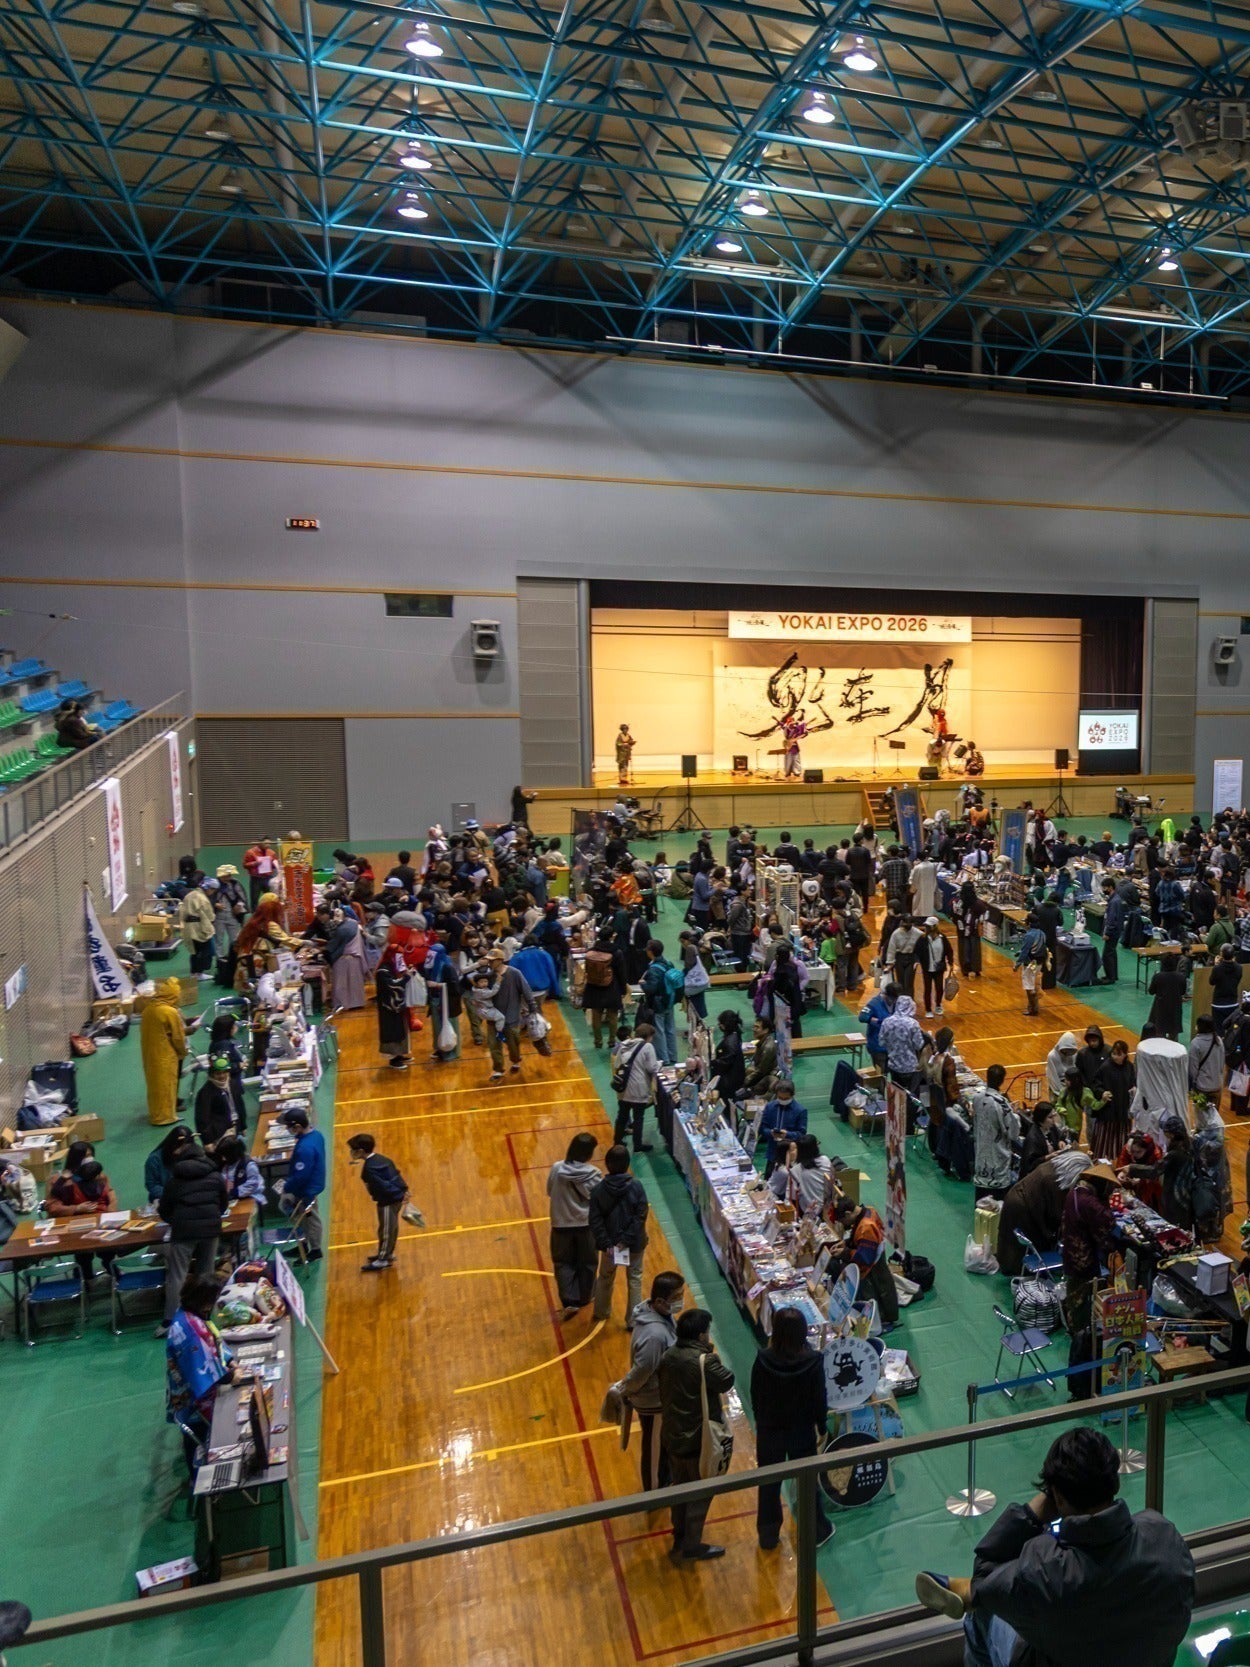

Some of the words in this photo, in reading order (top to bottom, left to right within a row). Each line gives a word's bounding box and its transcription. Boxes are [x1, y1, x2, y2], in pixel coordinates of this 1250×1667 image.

[778, 614, 832, 630] YOKAI
[837, 616, 883, 631] EXPO
[887, 617, 928, 632] 2026
[1105, 1312, 1144, 1328] 日本人形
